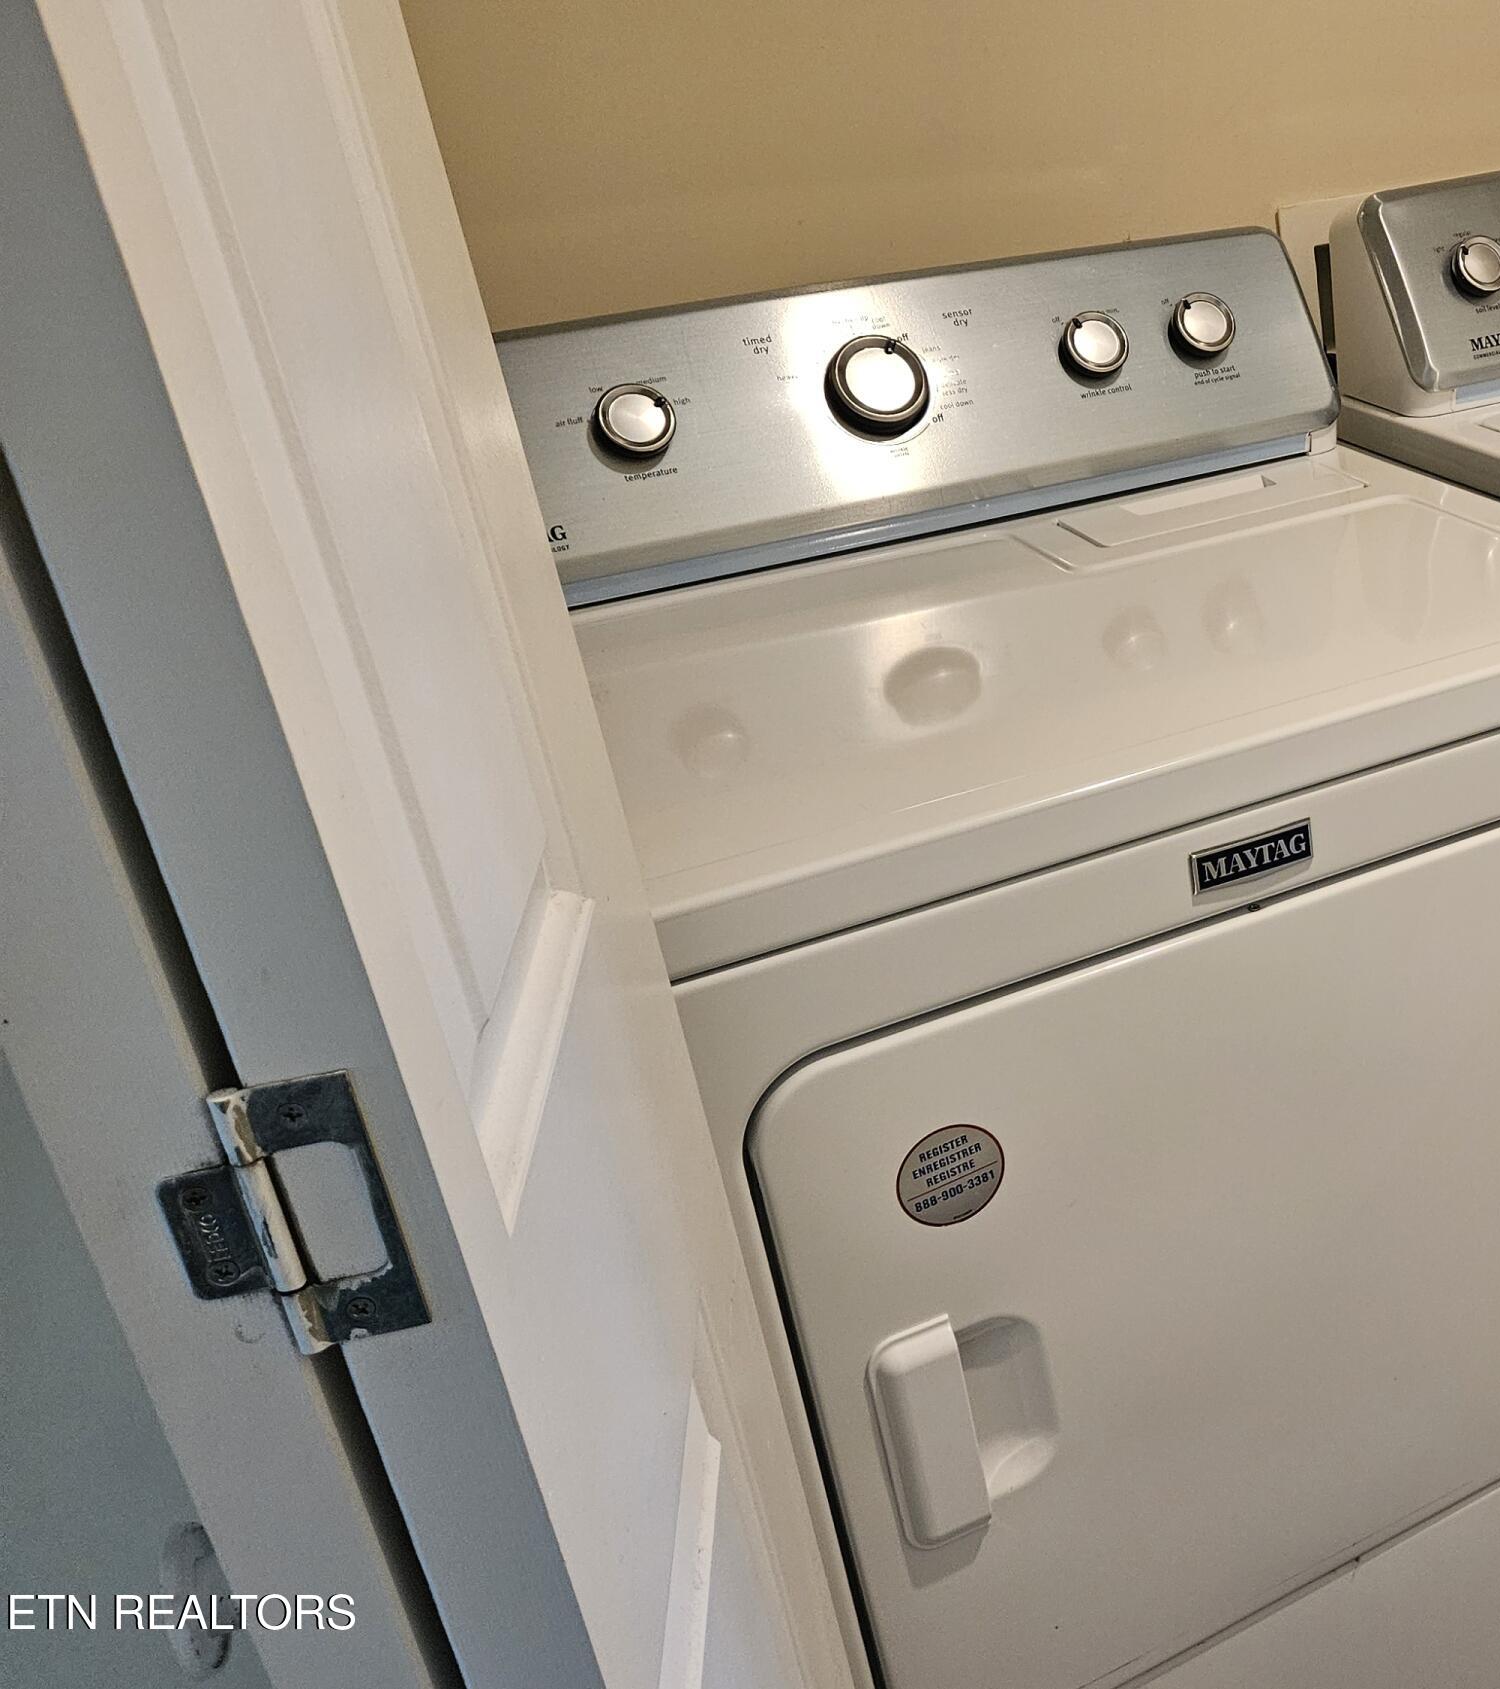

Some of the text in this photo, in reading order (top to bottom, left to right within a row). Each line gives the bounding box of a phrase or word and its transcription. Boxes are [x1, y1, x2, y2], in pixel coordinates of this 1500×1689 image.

[942, 308, 972, 320] sensor
[953, 316, 968, 327] dry
[742, 333, 772, 347] timed
[896, 333, 909, 343] off
[753, 344, 770, 356] dry
[1194, 365, 1236, 380] push to start
[1194, 379, 1204, 387] end
[1211, 376, 1225, 385] cycle
[1225, 373, 1241, 382] signal
[588, 386, 603, 394] low
[1080, 384, 1132, 400] wrinkle control
[673, 398, 690, 407] high
[955, 399, 974, 408] down
[555, 416, 584, 428] air fluff
[932, 413, 944, 424] off
[624, 466, 678, 482] temperature
[1202, 833, 1307, 882] MAYTAG
[919, 1134, 969, 1163] REGISTER
[912, 1142, 982, 1180] ENREGISTRER
[926, 1159, 976, 1187] REGISTRE
[915, 1169, 995, 1213] 888-900-3381
